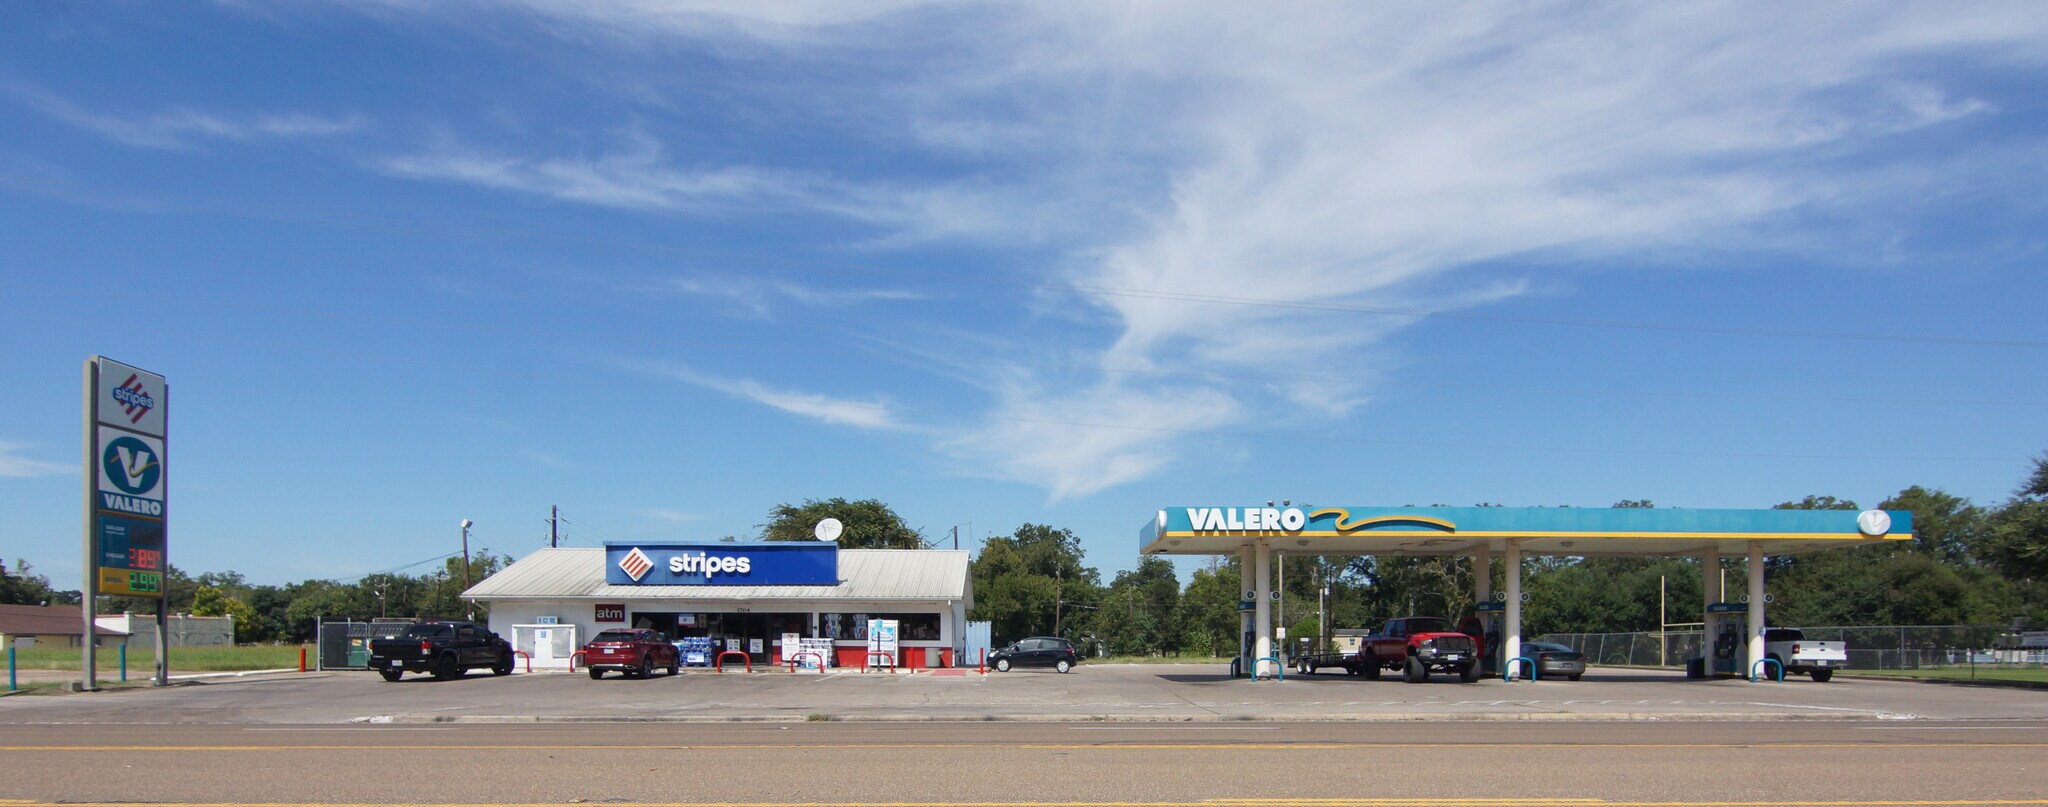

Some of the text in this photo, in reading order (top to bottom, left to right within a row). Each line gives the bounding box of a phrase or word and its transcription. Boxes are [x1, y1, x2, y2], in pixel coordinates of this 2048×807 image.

[114, 387, 154, 409] stripes
[117, 445, 150, 489] V
[105, 494, 161, 516] VALERO
[1187, 507, 1306, 532] VALERO
[669, 552, 751, 578] stripes
[596, 607, 623, 619] atm
